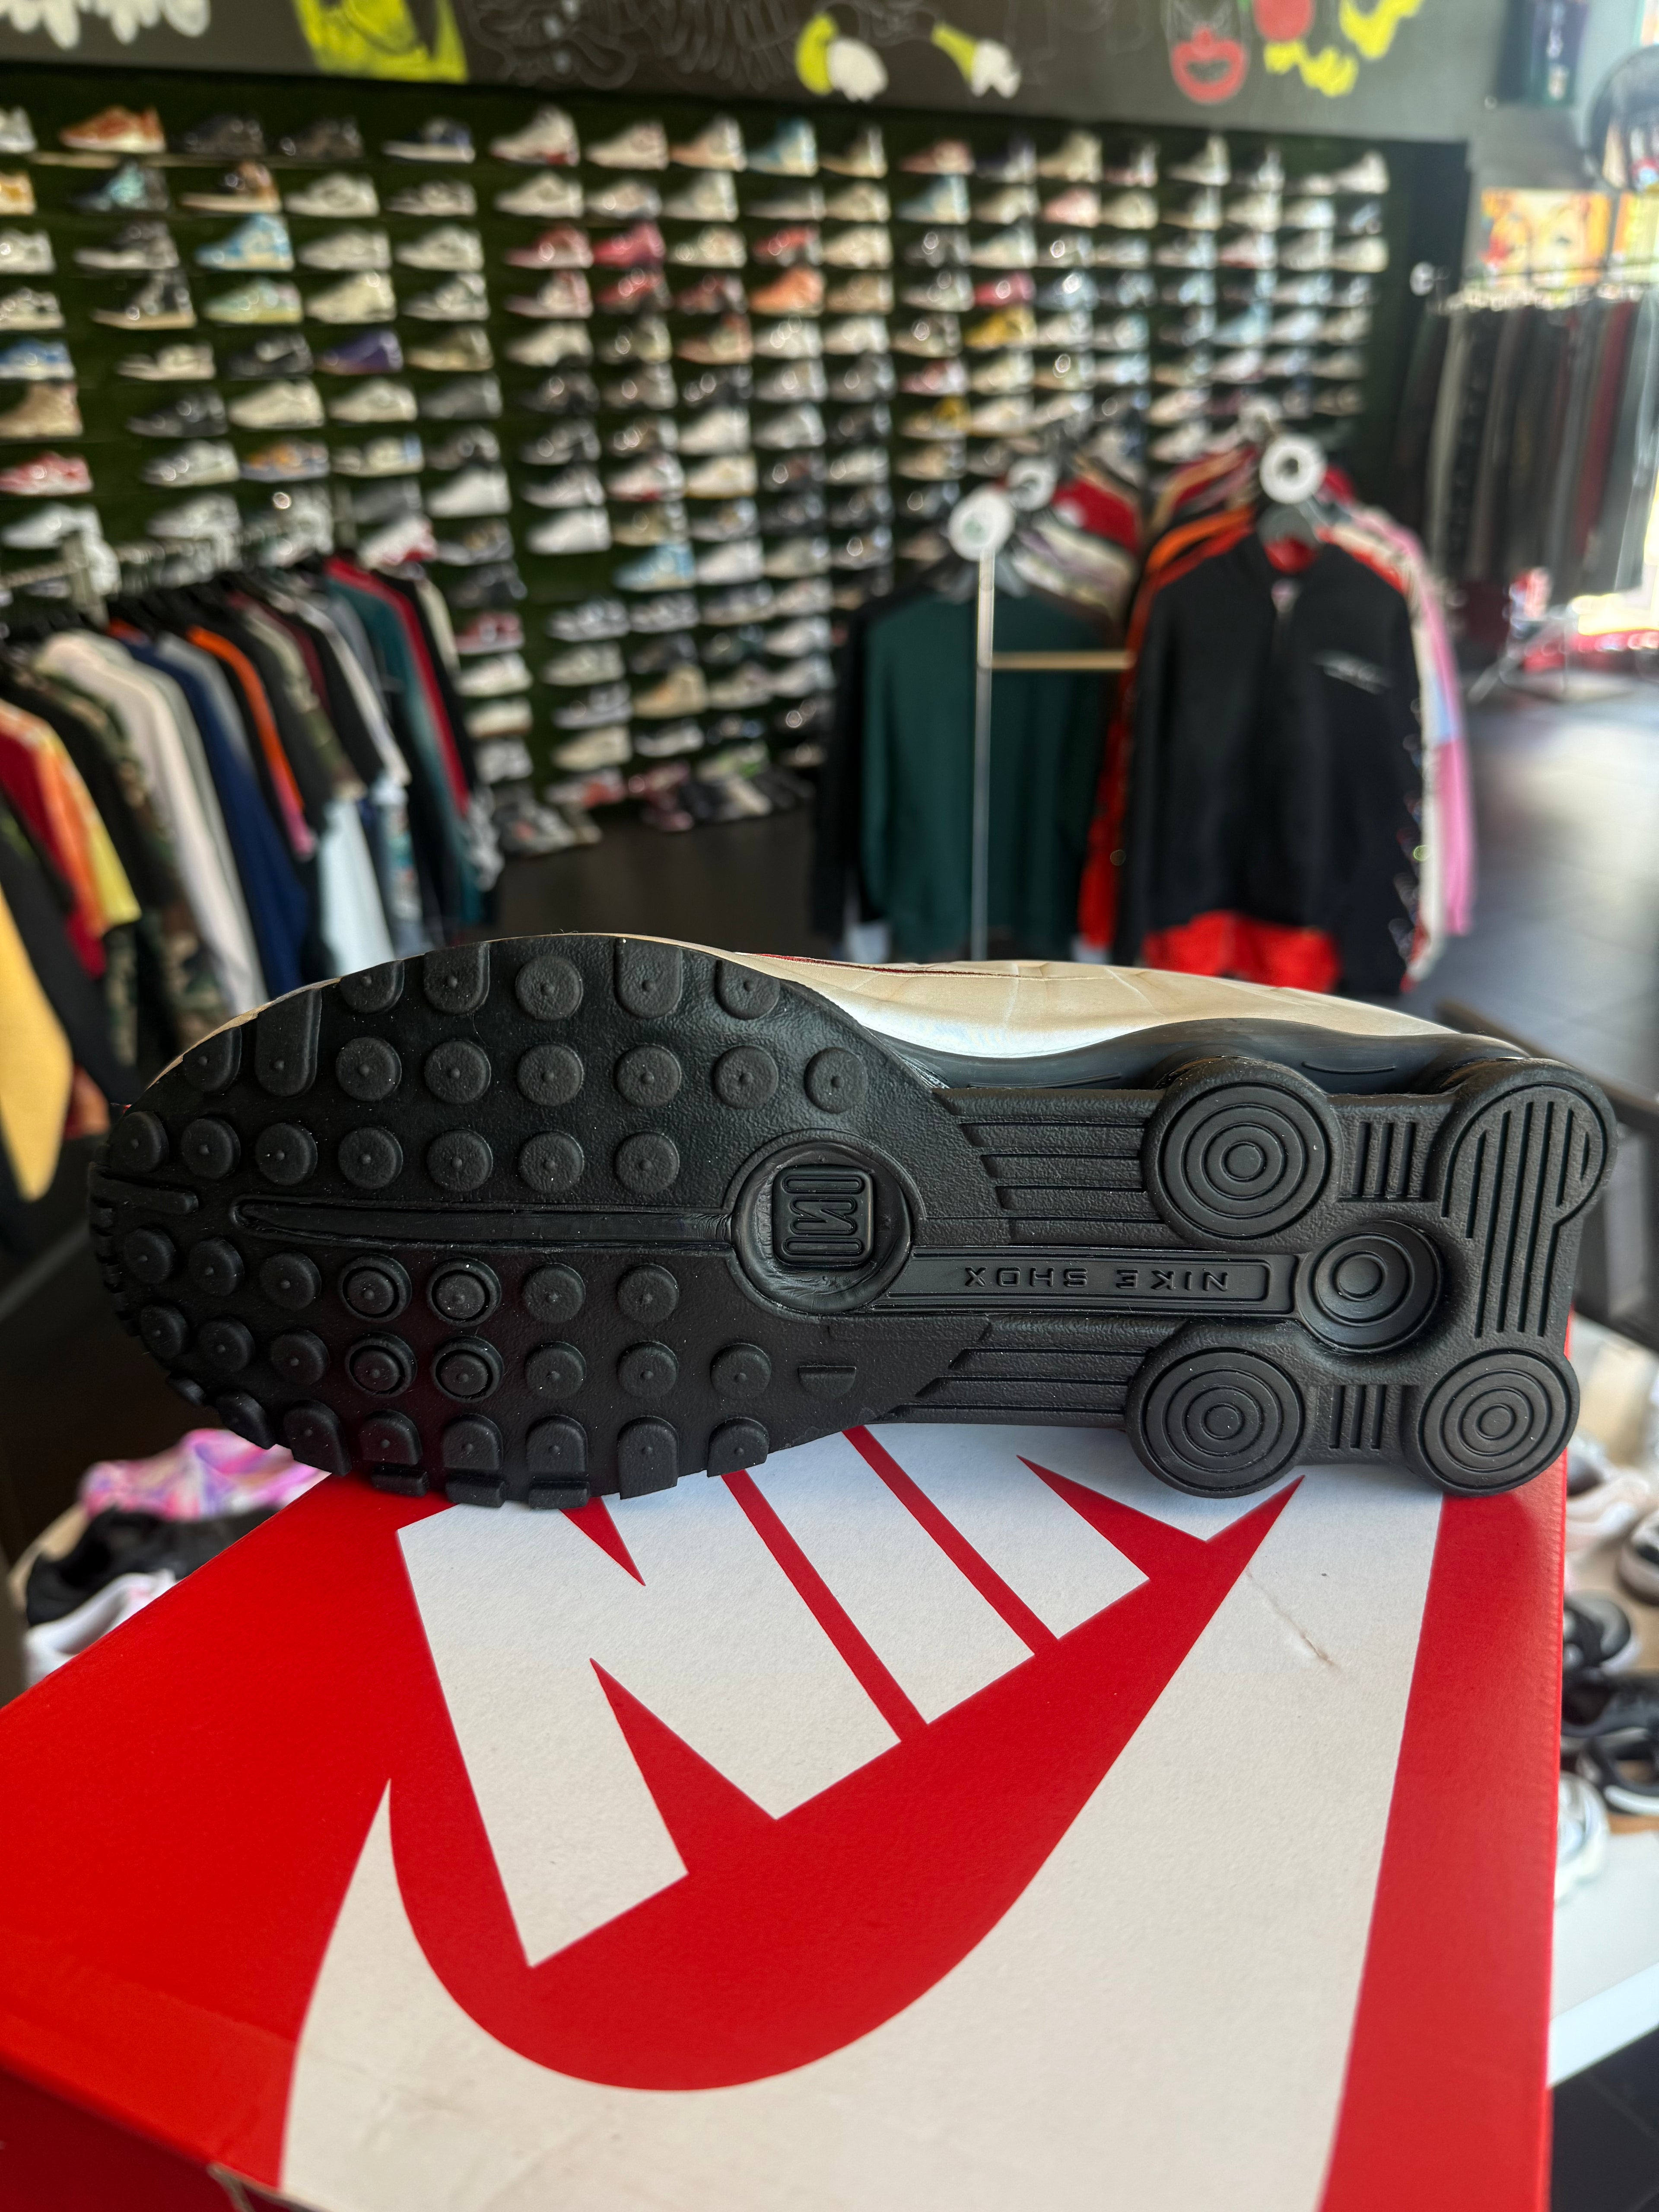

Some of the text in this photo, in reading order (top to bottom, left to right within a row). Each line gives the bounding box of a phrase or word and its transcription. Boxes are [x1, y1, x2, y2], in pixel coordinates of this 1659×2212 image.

[964, 1266, 1229, 1292] NIKE SHOX
[397, 1424, 1303, 1968] NIK
